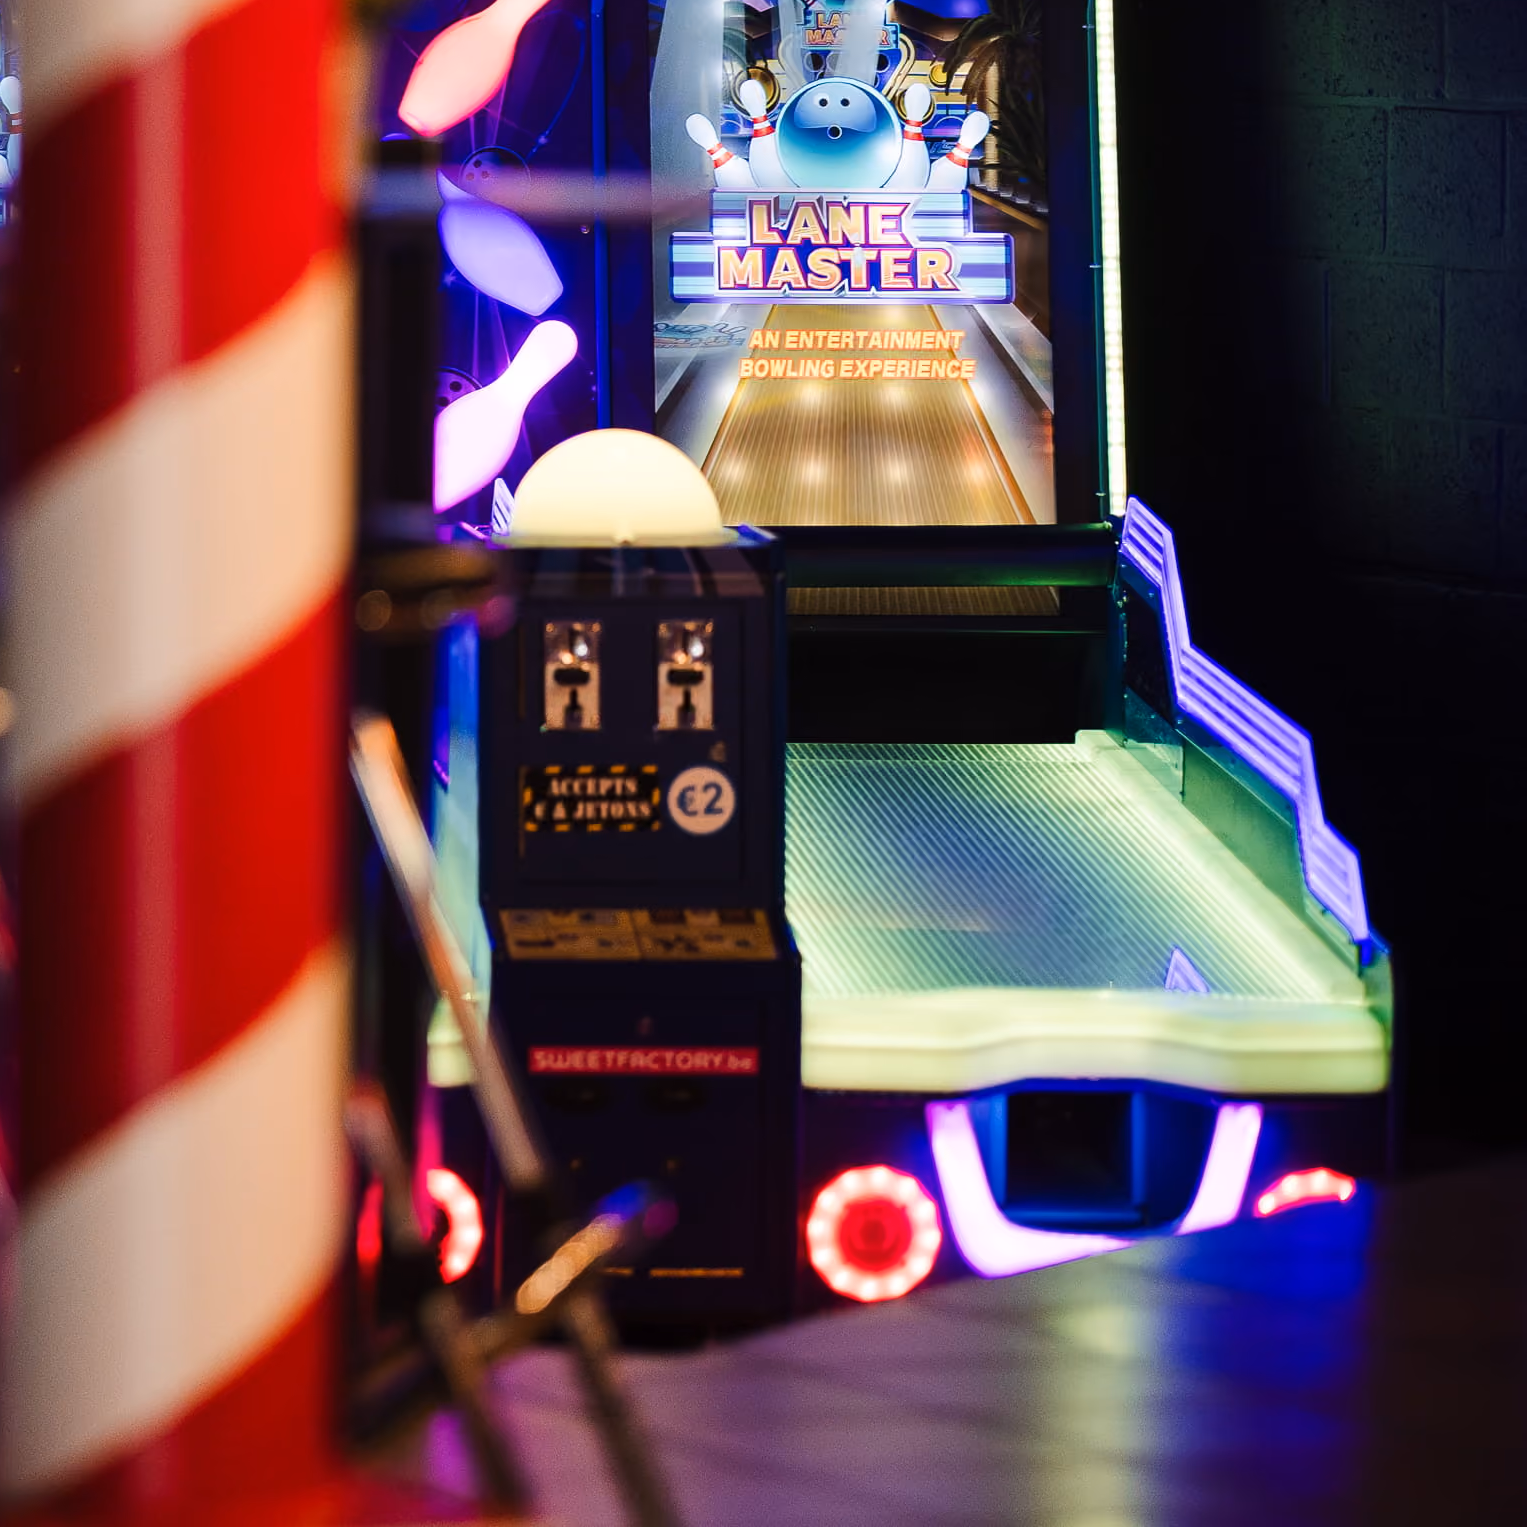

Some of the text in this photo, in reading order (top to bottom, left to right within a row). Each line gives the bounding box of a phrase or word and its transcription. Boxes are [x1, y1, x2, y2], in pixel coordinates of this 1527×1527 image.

[749, 200, 910, 245] LANE
[718, 247, 960, 290] MASTER
[749, 330, 782, 350] AN
[784, 330, 965, 351] ENTERTAINMENT
[739, 357, 976, 380] BOWLING EXPERIENCE
[550, 778, 638, 796] ACCEPTS
[574, 802, 652, 819] JETONS
[677, 782, 723, 816] €2
